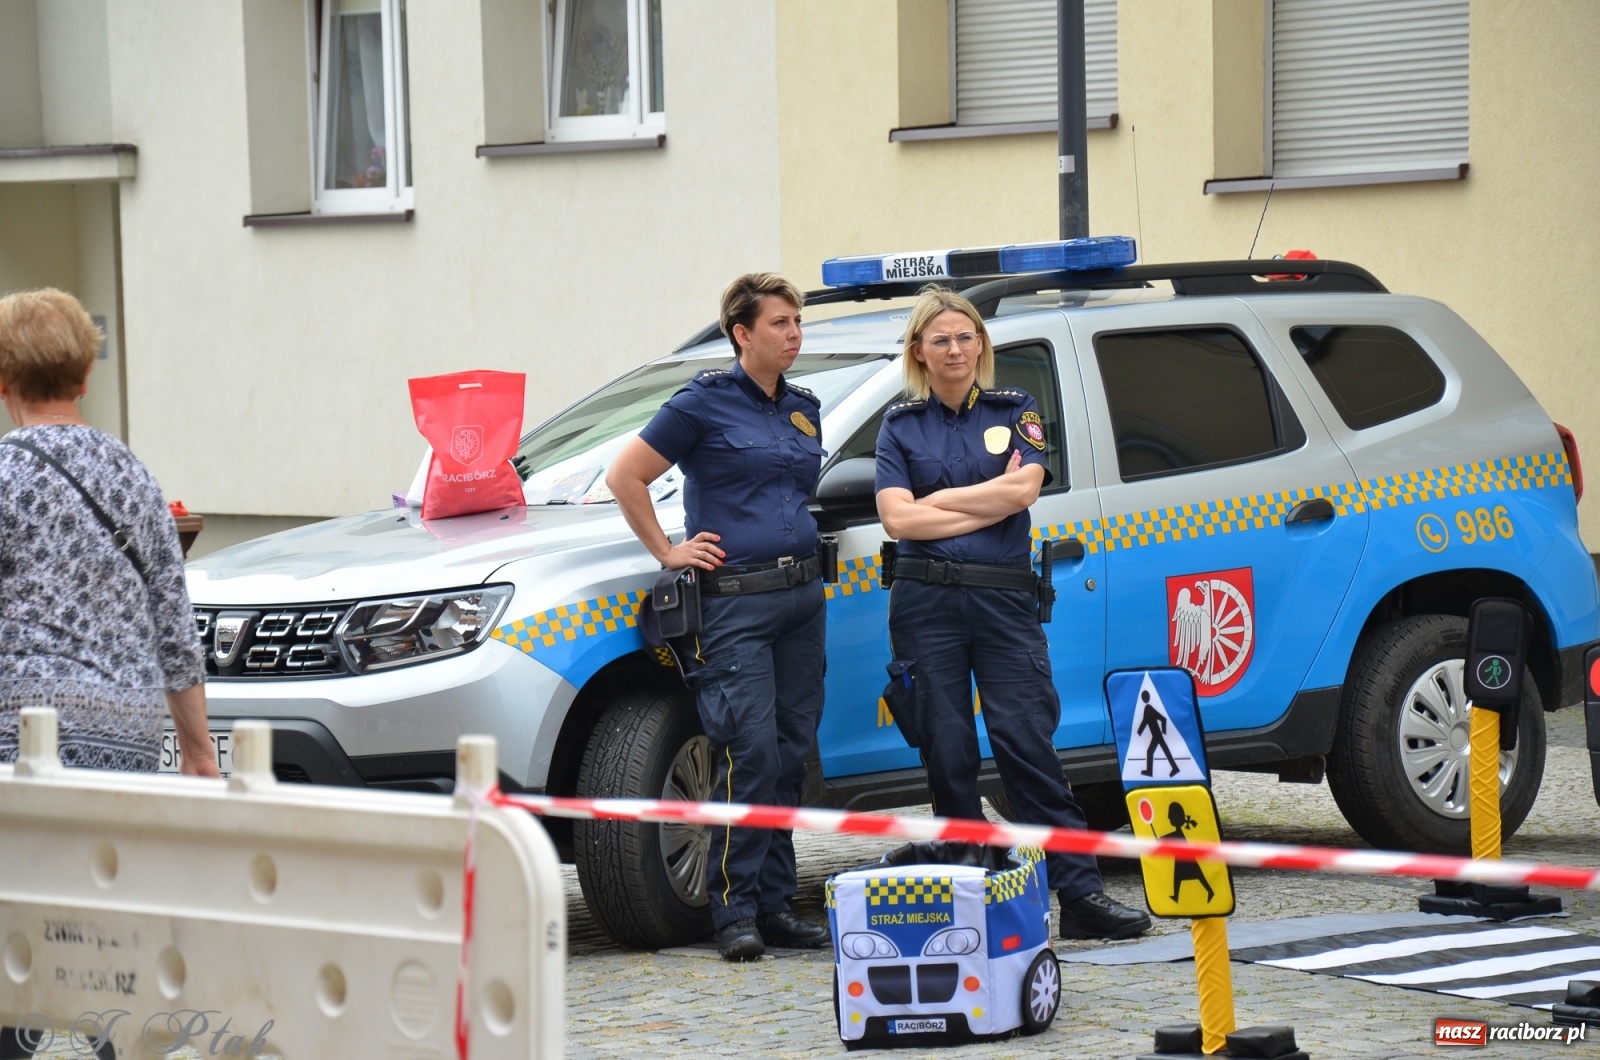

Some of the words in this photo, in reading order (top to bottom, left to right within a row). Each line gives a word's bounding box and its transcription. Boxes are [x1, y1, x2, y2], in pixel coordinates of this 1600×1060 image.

[885, 264, 944, 279] MIEJSKA
[441, 469, 497, 484] RACIBÓRZ
[1455, 505, 1514, 545] 986
[870, 911, 905, 926] STRAŻ
[906, 912, 951, 925] MIEJSKA
[897, 1020, 945, 1031] RACIBÓRZ
